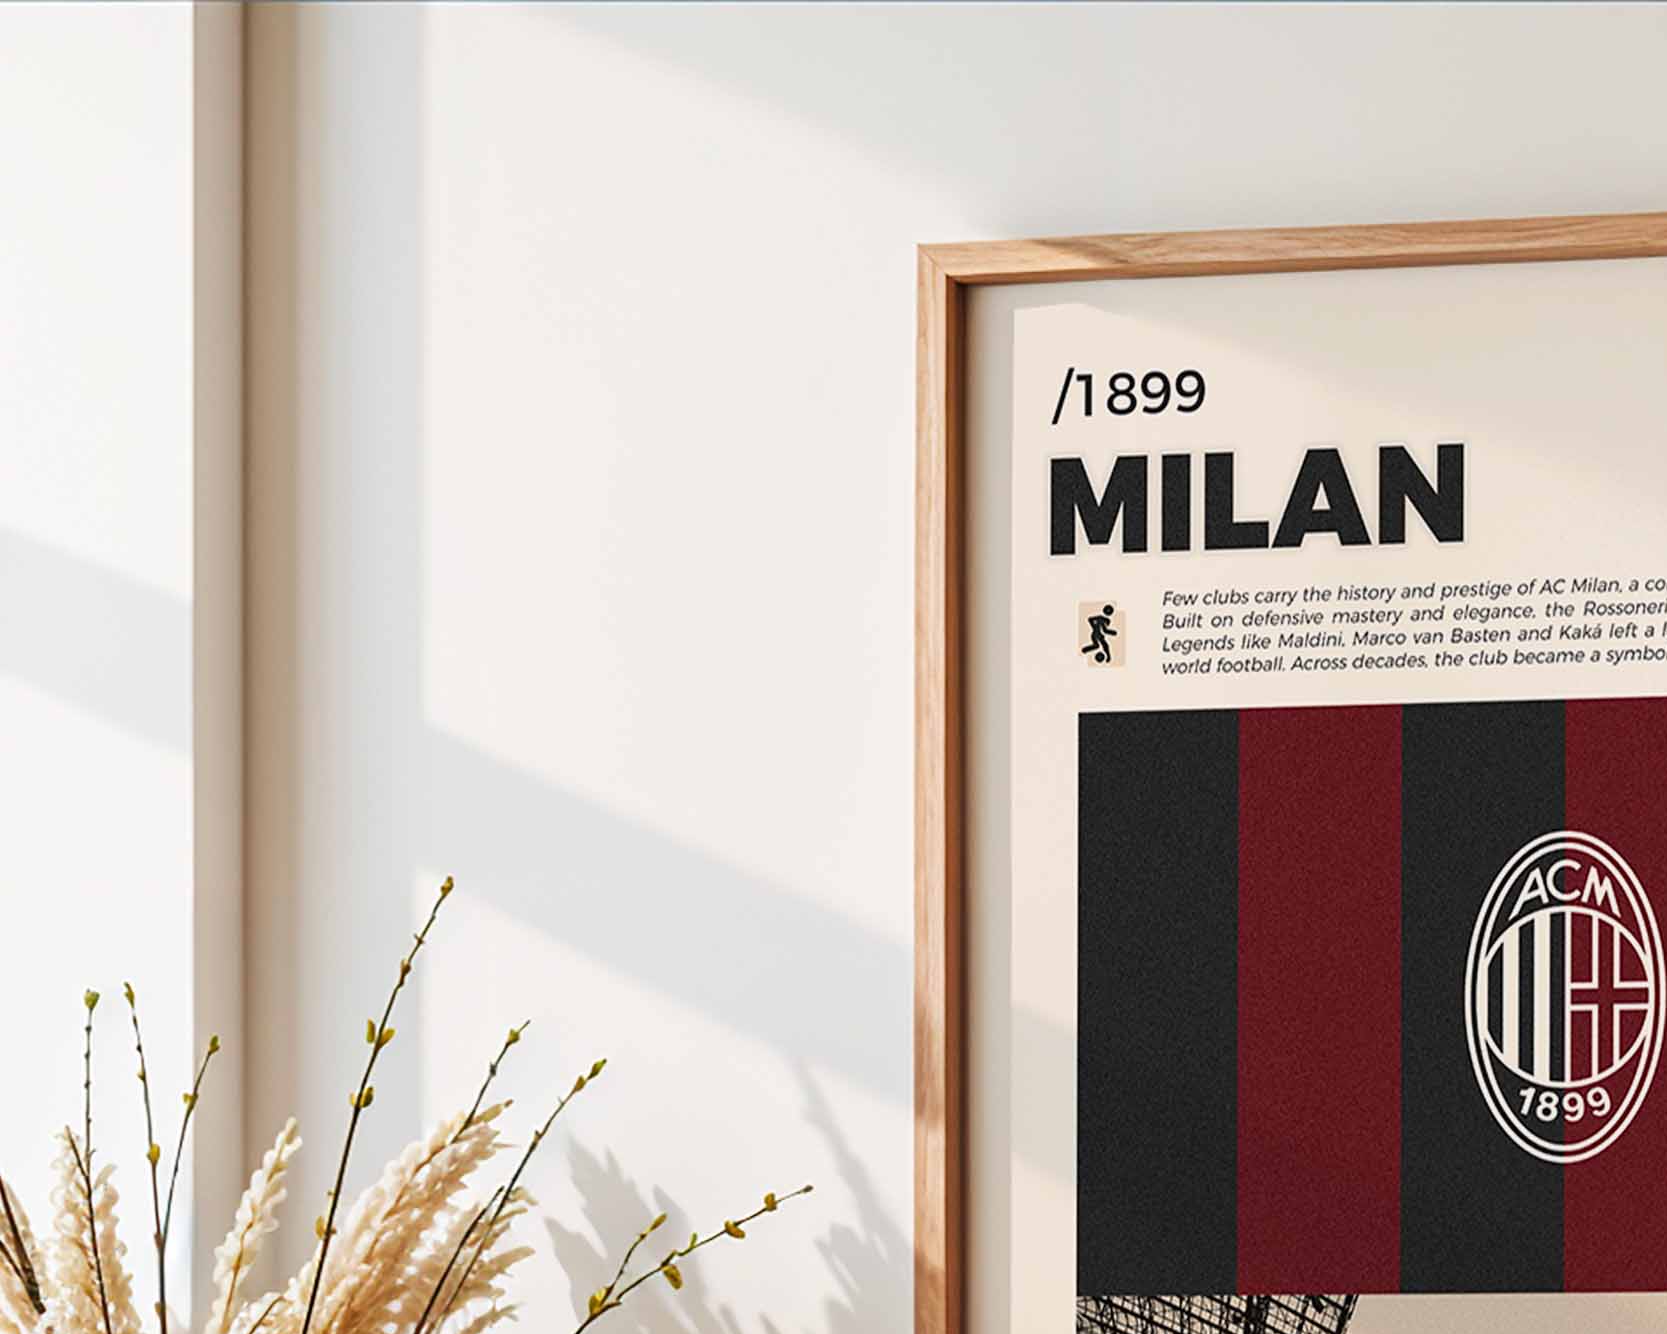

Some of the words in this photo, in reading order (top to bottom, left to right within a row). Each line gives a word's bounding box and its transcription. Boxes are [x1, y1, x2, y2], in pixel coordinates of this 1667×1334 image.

[1052, 368, 1205, 425] /1899
[1050, 443, 1464, 556] MILAN
[1163, 591, 1198, 607] Few
[1202, 589, 1249, 605] clubs
[1254, 590, 1298, 607] carry
[1303, 586, 1332, 602] the
[1337, 585, 1396, 604] history
[1401, 582, 1435, 599] and
[1440, 580, 1512, 601] prestige
[1517, 579, 1537, 596] of
[1539, 578, 1566, 594] AC
[1628, 579, 1639, 592] a
[1163, 613, 1203, 629] Built
[1211, 616, 1233, 628] on
[1242, 609, 1324, 627] defensive
[1332, 609, 1403, 626] mastery
[1410, 605, 1445, 622] and
[1545, 601, 1575, 618] the
[1163, 635, 1235, 655] Legends
[1241, 634, 1271, 649] like
[1352, 630, 1407, 646] Marco
[1413, 632, 1444, 644] van
[1450, 628, 1511, 644] Basten
[1517, 625, 1553, 642] and
[1559, 623, 1602, 640] Kaká
[1609, 622, 1638, 639] left
[1644, 626, 1655, 638] a
[1162, 658, 1212, 675] world
[1217, 656, 1285, 673] football.
[1290, 656, 1347, 671] Across
[1435, 651, 1464, 667] the
[1469, 649, 1508, 666] club
[1513, 649, 1585, 665] became
[1590, 650, 1601, 662] a
[1508, 859, 1621, 920] ACM
[1518, 1087, 1611, 1122] 1899
